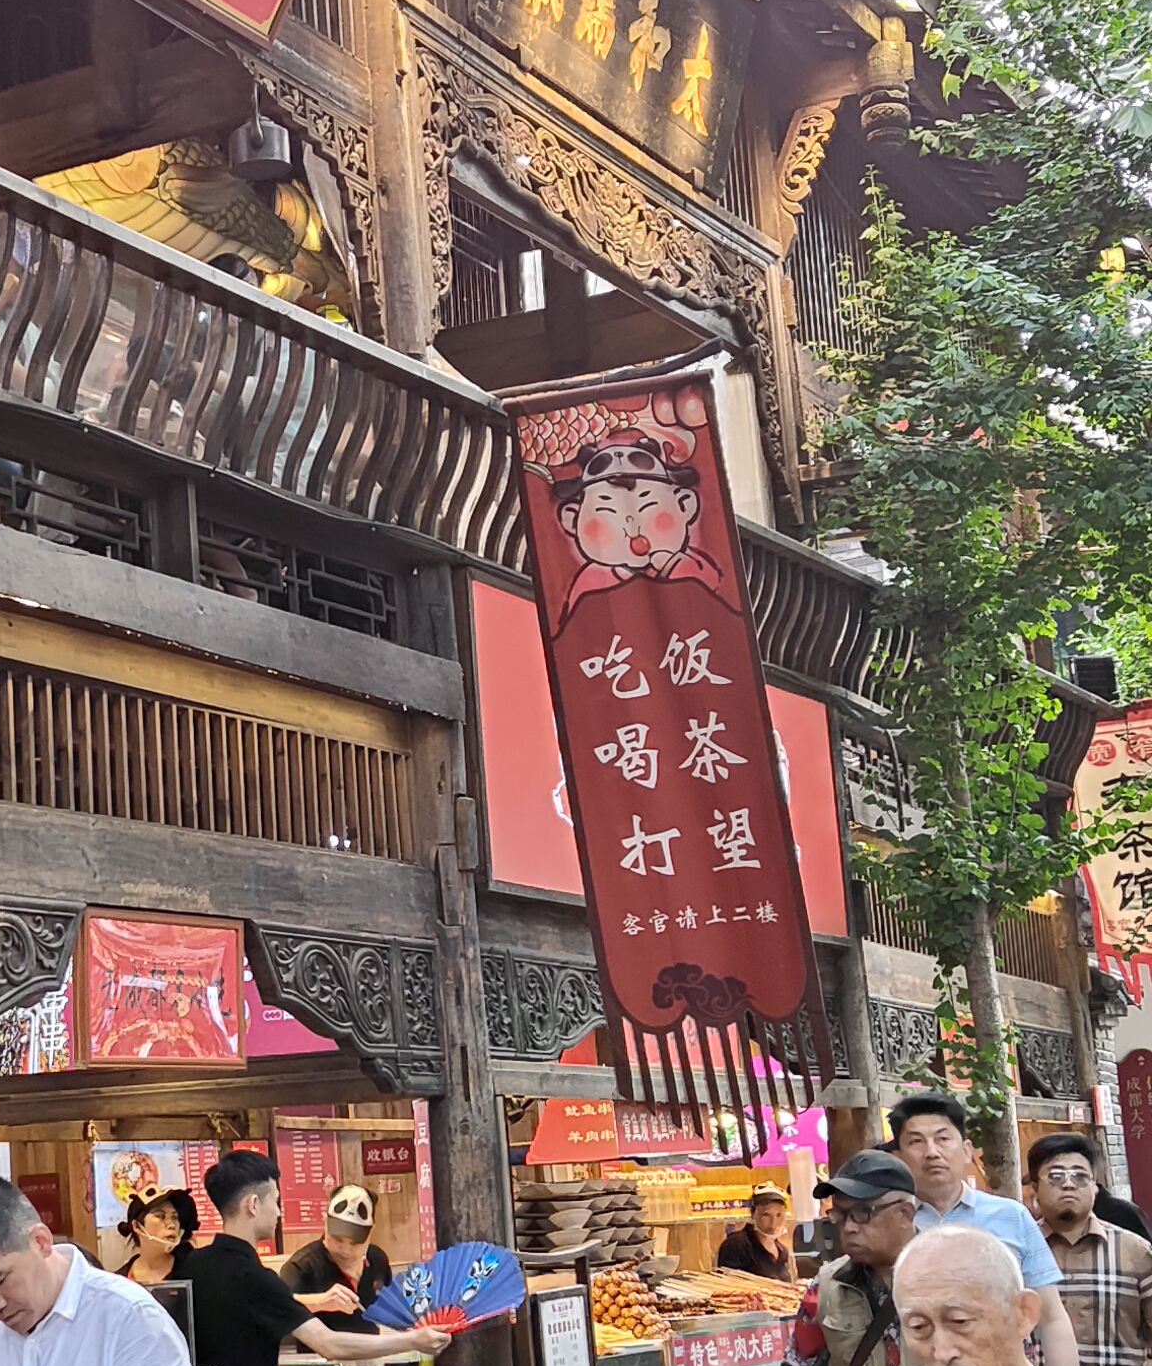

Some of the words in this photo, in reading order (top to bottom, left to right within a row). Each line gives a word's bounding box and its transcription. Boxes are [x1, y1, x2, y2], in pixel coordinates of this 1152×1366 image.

[622, 900, 779, 936] 客官请上二楼
[1126, 1077, 1147, 1140] 成都大学
[568, 1130, 615, 1143] 羊肉串
[366, 1146, 410, 1162] 收银台
